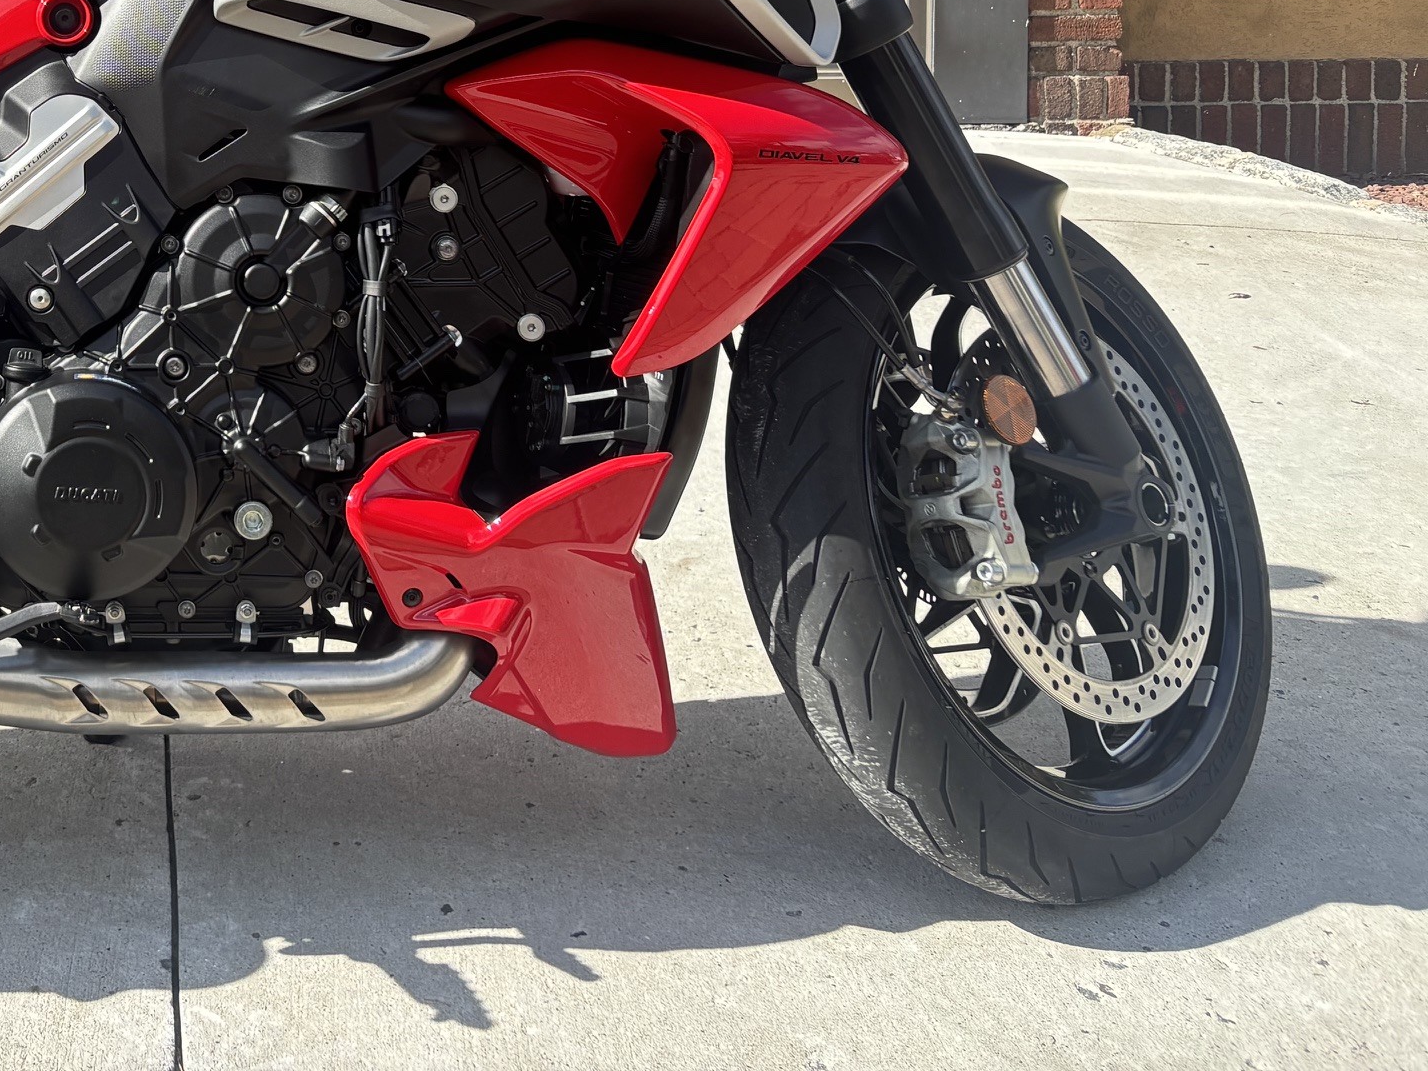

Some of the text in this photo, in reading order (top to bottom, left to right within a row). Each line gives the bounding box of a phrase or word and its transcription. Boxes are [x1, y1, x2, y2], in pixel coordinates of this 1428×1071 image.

[758, 149, 861, 164] DIAVEL V4
[16, 350, 34, 361] OIL
[54, 486, 122, 503] DUCATI
[991, 464, 1015, 545] brembo
